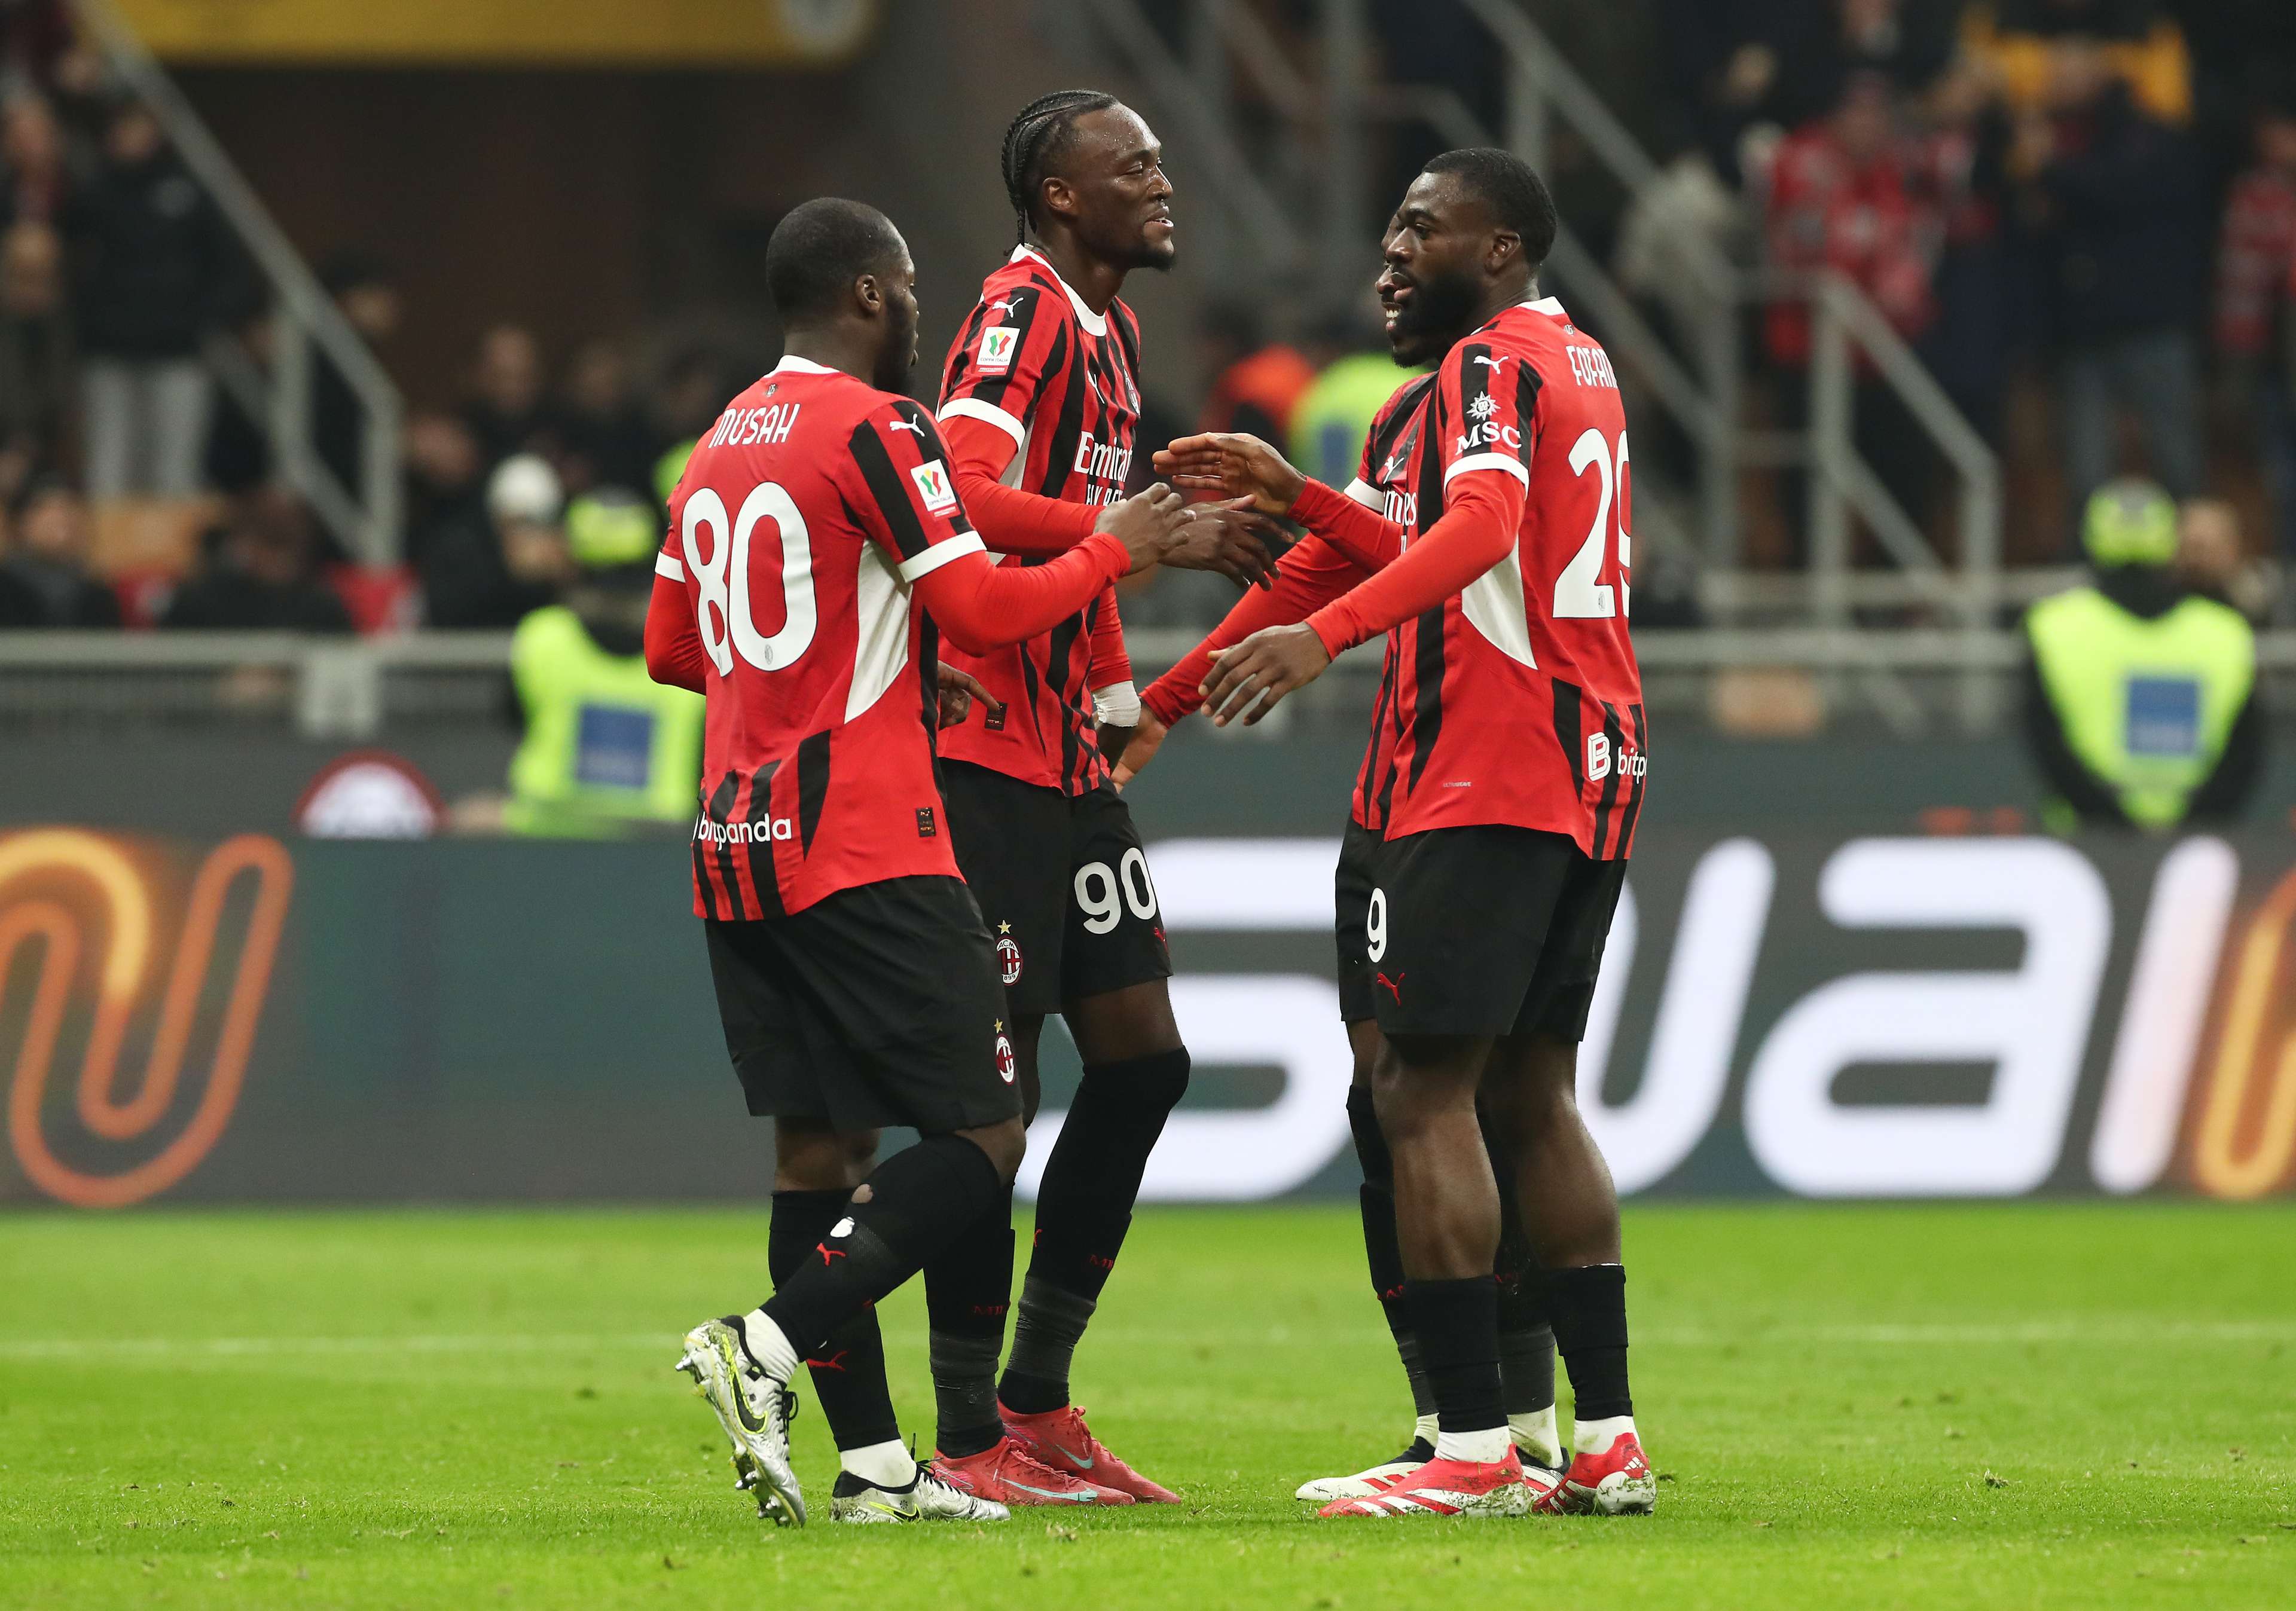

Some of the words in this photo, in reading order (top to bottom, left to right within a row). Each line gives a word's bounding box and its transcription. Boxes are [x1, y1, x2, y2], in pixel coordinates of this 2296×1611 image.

[709, 403, 800, 448] MUSAH
[1455, 421, 1522, 456] MSC
[682, 482, 817, 677] 80
[1617, 746, 1648, 784] bitp
[698, 811, 792, 851] bitpanda
[1074, 847, 1156, 934] 90
[999, 940, 1015, 949] ACM
[1367, 887, 1387, 962] 9
